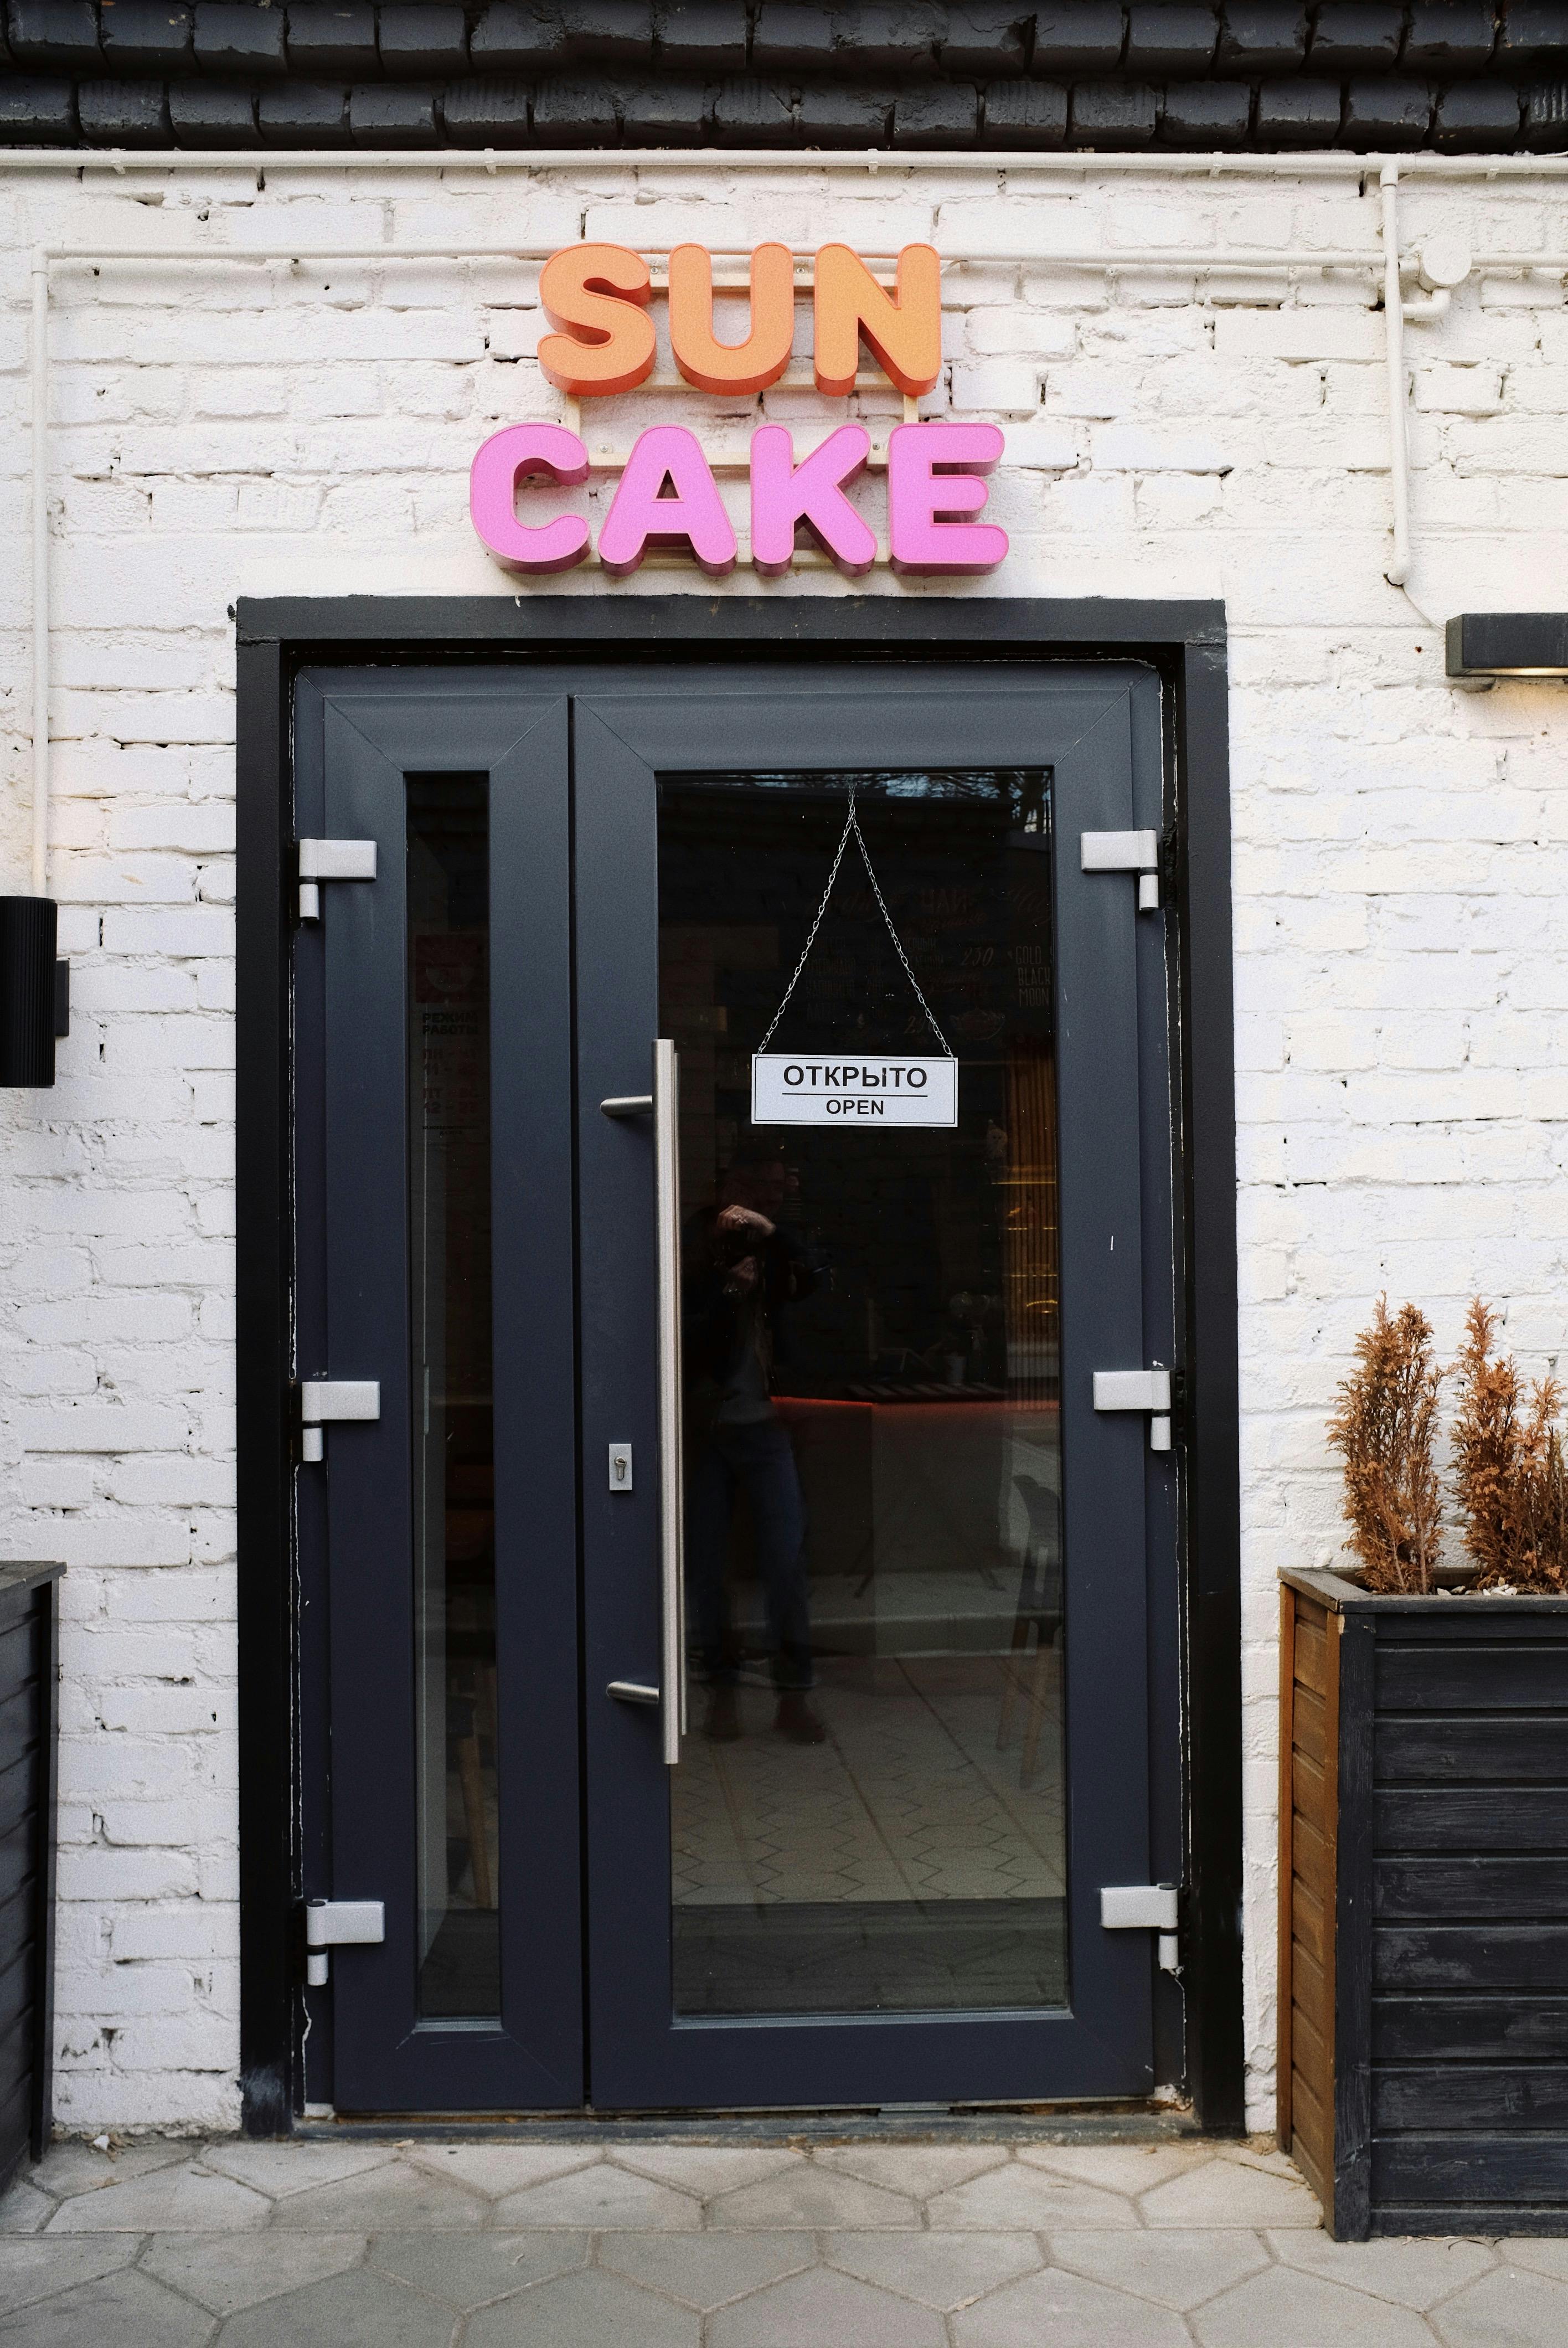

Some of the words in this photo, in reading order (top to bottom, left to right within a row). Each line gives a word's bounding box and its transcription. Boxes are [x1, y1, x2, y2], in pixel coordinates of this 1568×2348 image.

[537, 242, 941, 397] SUN
[470, 422, 1009, 577] CAKE
[1016, 945, 1041, 965] GOLD
[1018, 967, 1051, 986] BLACK
[1019, 988, 1049, 1007] MOON
[422, 1012, 478, 1023] РЕЖИМ
[422, 1025, 478, 1035] РАБОТЫ
[783, 1065, 927, 1088] ОТКРЫТО
[826, 1099, 884, 1115] OPEN
